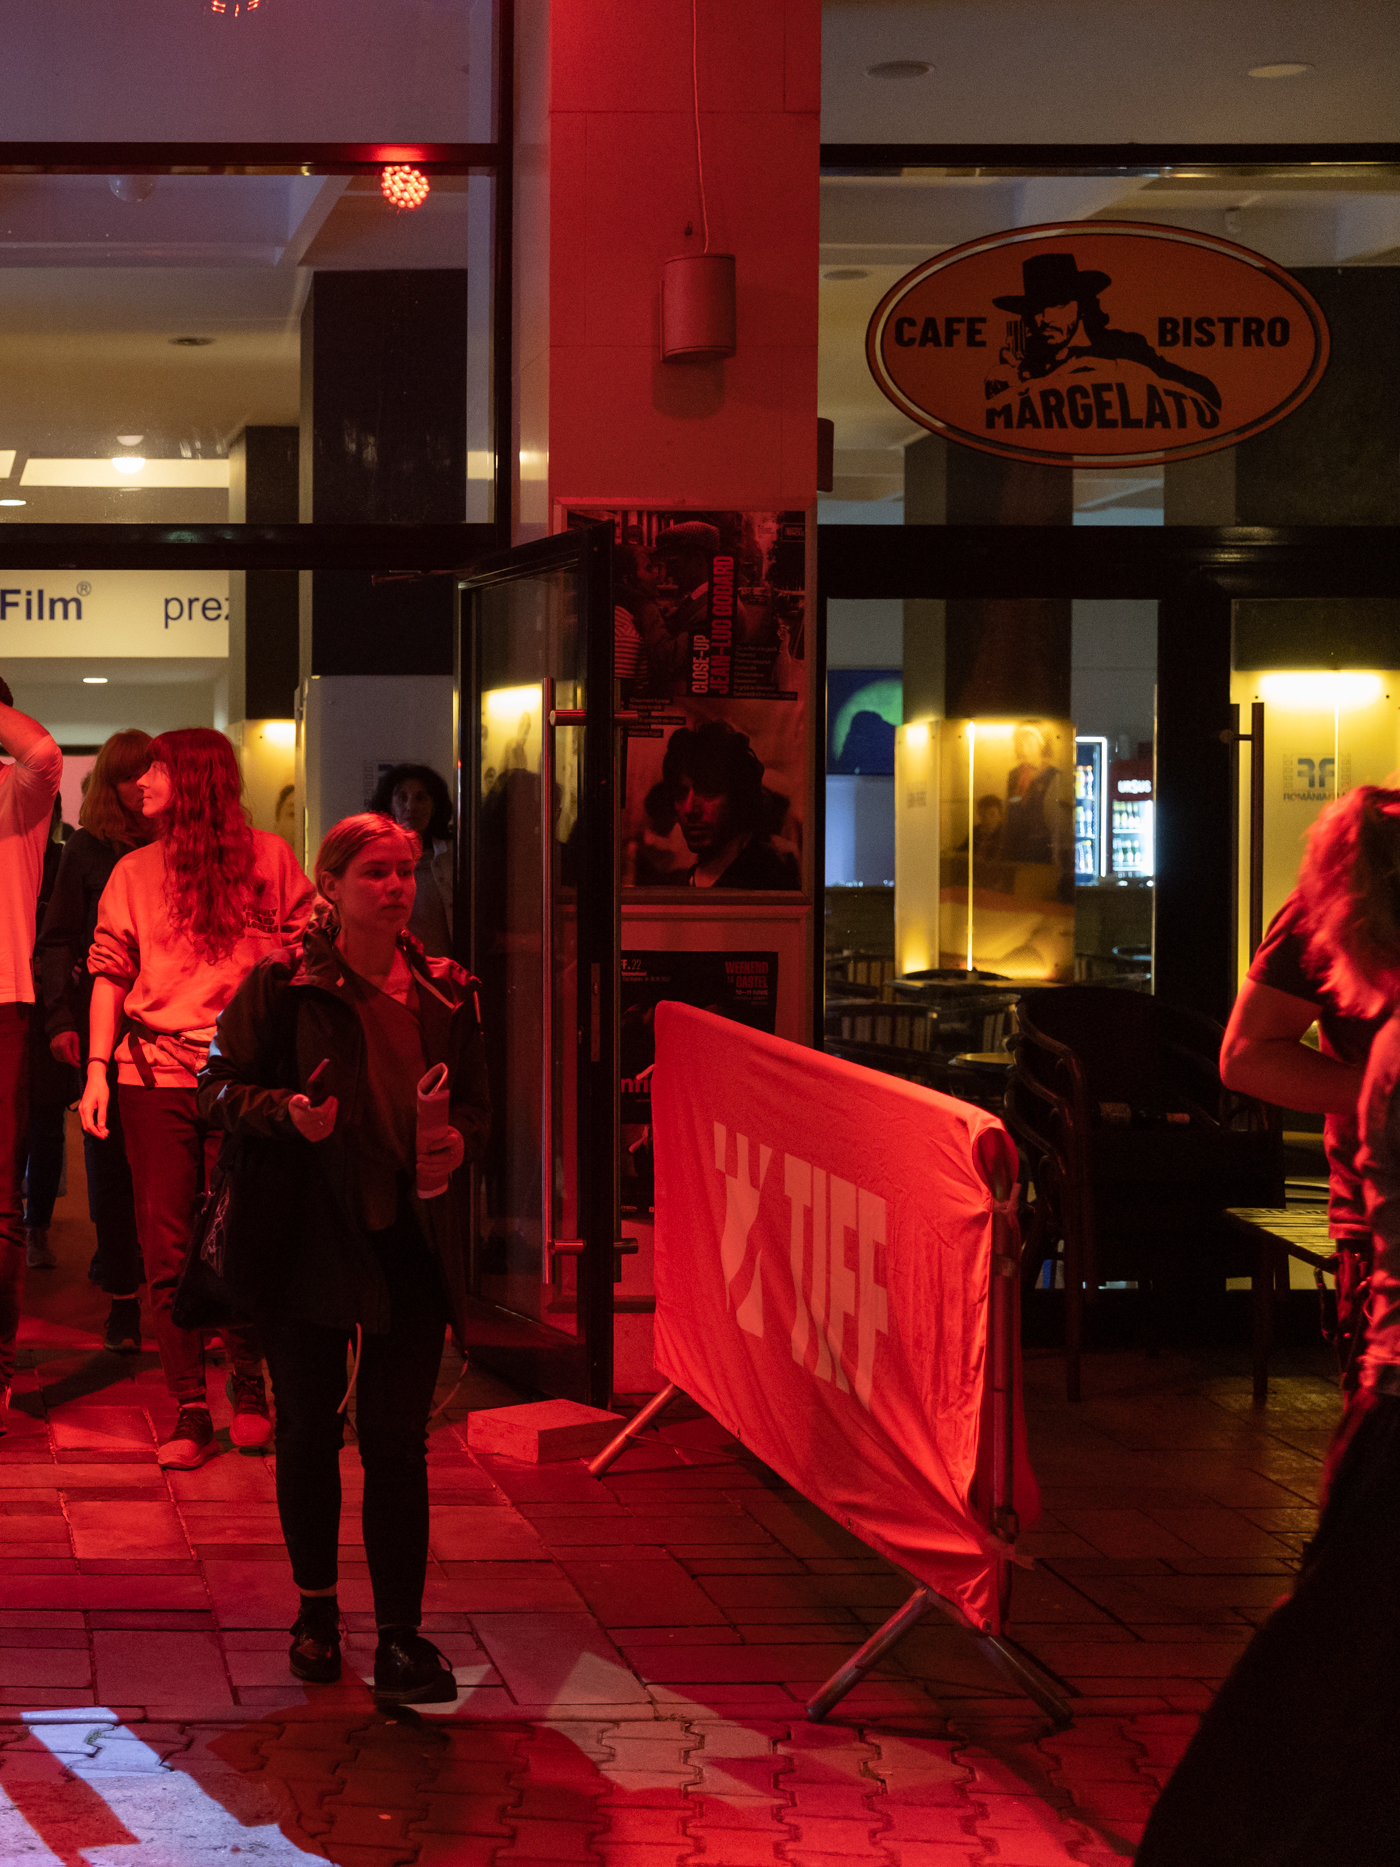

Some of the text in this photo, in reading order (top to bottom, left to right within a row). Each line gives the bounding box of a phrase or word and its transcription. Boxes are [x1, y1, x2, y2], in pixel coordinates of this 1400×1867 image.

[894, 316, 1291, 348] CAFE BISTRO
[712, 556, 735, 617] GODARD
[724, 961, 769, 974] WEEKEND
[735, 975, 769, 989] CASTEL
[784, 1152, 889, 1414] TIFF
